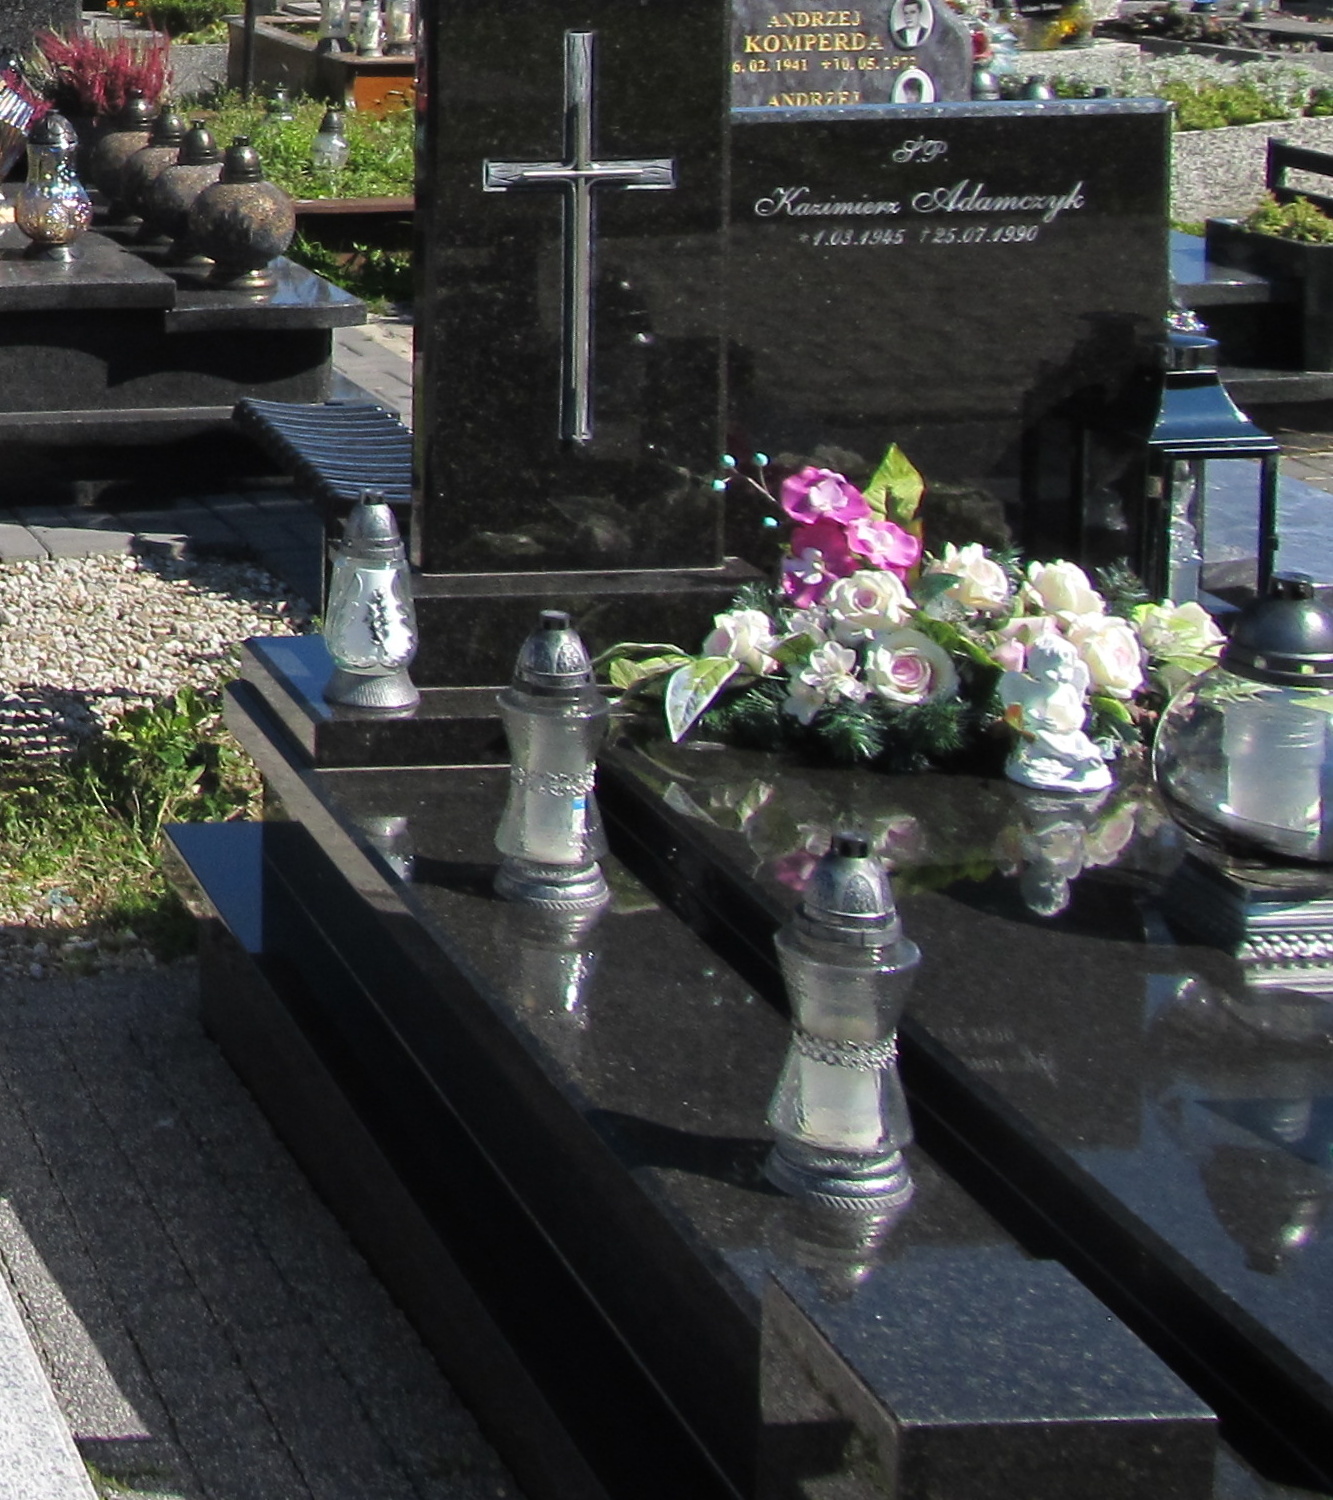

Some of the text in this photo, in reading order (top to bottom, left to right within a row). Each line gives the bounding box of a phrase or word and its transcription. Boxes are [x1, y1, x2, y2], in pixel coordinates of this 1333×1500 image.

[767, 11, 861, 28] ANDRZEJ
[744, 34, 883, 53] KOMPERDA
[768, 92, 861, 107] ANDRZEJ
[755, 179, 1085, 223] Kazimierz Adamczyk
